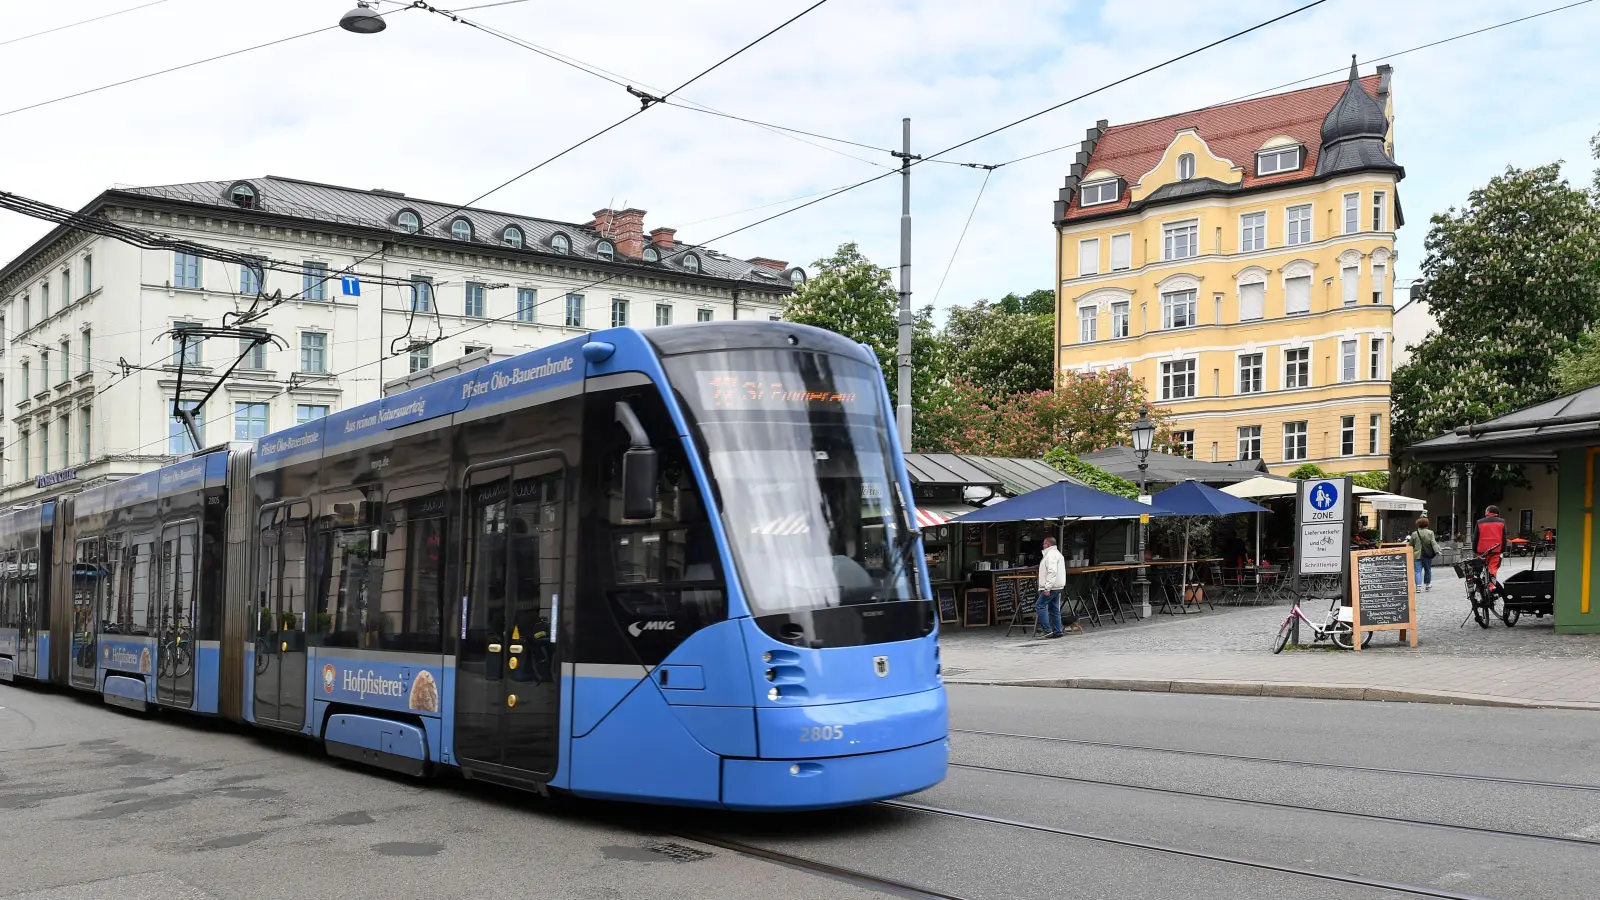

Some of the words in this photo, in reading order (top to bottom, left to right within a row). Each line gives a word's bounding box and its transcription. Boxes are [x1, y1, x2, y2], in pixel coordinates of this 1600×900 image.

[491, 356, 574, 391] Öko-Bauernbrote
[344, 420, 356, 433] Aus
[356, 414, 377, 429] reinem
[377, 397, 426, 424] Natursauerteig
[208, 496, 220, 505] 2805
[1312, 512, 1334, 520] ZONE
[642, 620, 676, 631] MVG
[342, 669, 402, 700] Hofpfisterei
[799, 725, 844, 742] 2805
